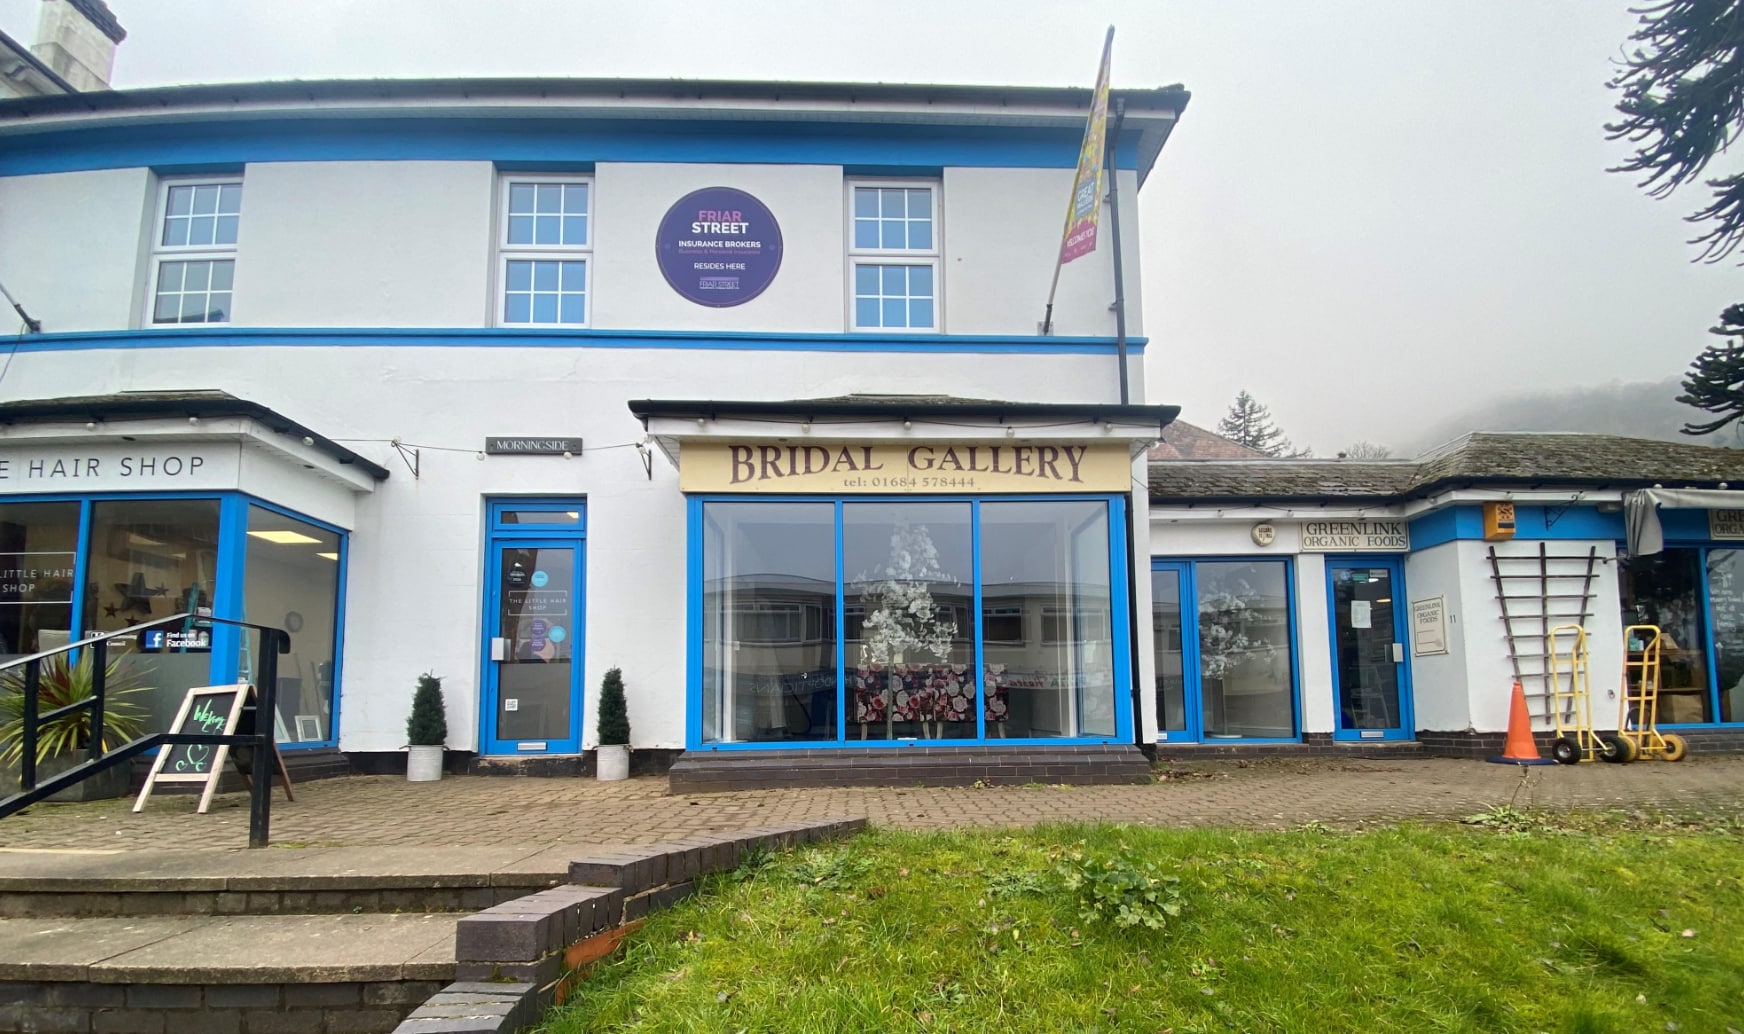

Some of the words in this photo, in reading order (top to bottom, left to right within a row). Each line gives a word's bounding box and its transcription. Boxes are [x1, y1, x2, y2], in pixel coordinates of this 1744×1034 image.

[698, 210, 742, 222] FRIAR
[691, 222, 749, 234] STREET
[678, 240, 724, 248] INSURANCE
[693, 262, 725, 270] RESIDES
[496, 440, 569, 450] MORNINGSIDE
[28, 458, 101, 479] HAIR
[119, 456, 204, 477] SHOP
[729, 444, 884, 485] BRIDAL
[907, 444, 1087, 483] GALLERY
[844, 477, 867, 487] tel:
[871, 477, 916, 487] 01684
[922, 477, 974, 487] 578444
[1306, 522, 1402, 536] GREENLINK
[1303, 536, 1360, 547] ORGANIC
[1367, 536, 1406, 547] FOODS
[43, 569, 74, 578] HAIR
[2, 583, 36, 593] SHOP
[166, 638, 207, 647] Facebook
